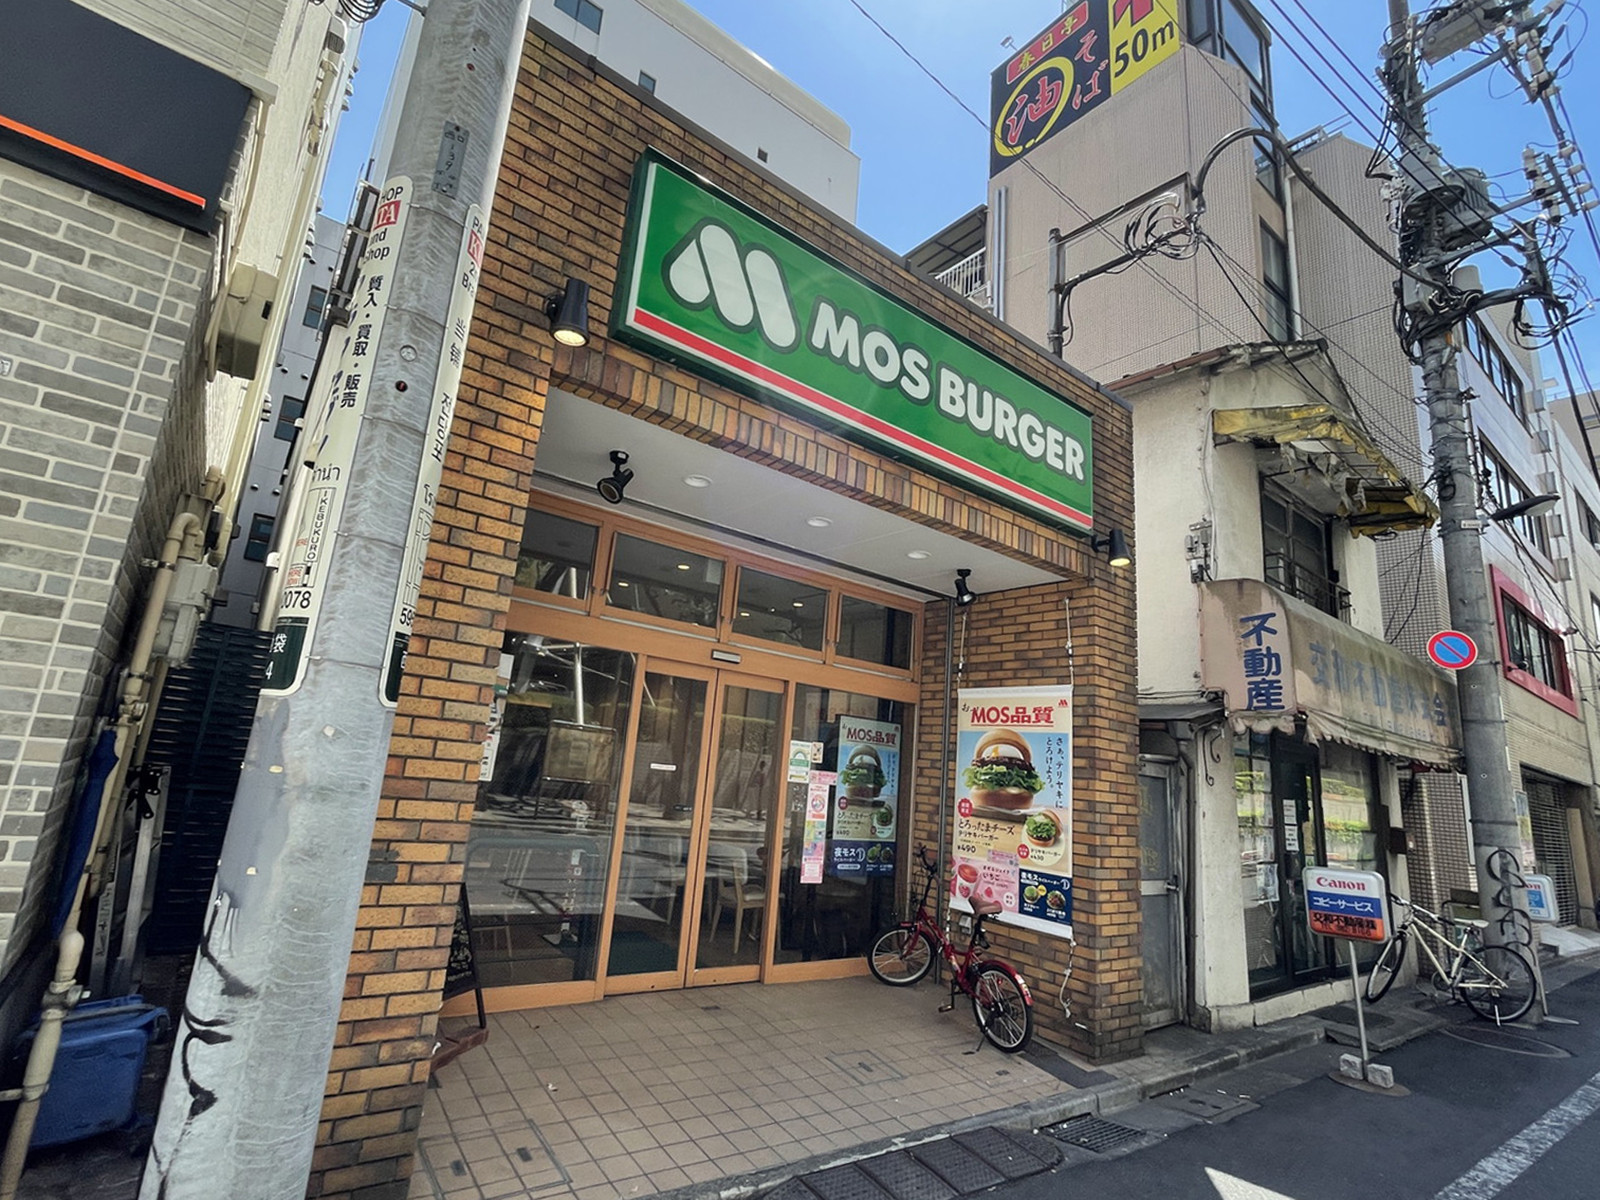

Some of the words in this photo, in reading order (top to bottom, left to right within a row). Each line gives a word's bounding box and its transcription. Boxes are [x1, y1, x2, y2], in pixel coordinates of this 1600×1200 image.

[1071, 29, 1109, 110] そば
[1114, 20, 1175, 79] 50m
[1005, 75, 1062, 145] 油
[810, 300, 932, 401] MOS
[938, 366, 1086, 482] BURGER
[306, 490, 328, 560] IKEBUKURO
[1239, 611, 1285, 711] 不動産
[846, 727, 896, 745] MOS品質
[970, 706, 1054, 724] MOS品質
[1312, 896, 1373, 913] コピーサービス
[1316, 876, 1366, 891] Canon
